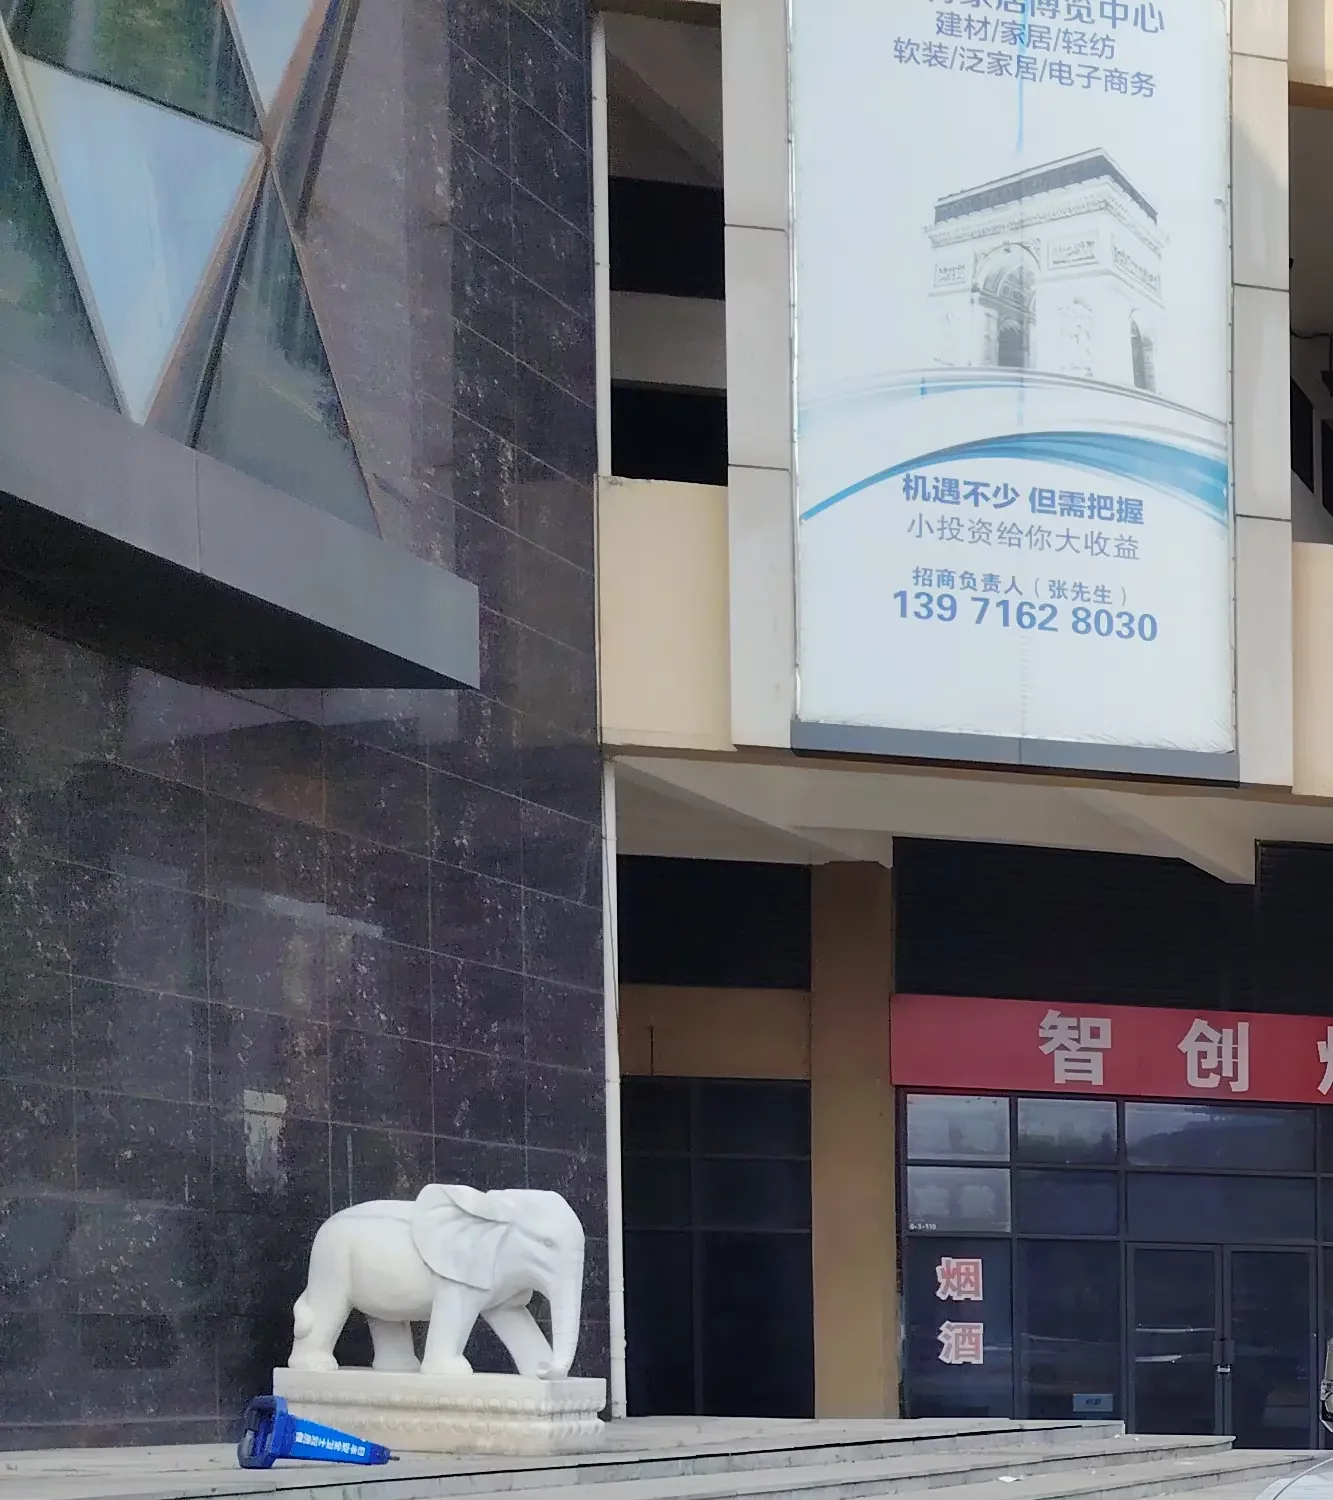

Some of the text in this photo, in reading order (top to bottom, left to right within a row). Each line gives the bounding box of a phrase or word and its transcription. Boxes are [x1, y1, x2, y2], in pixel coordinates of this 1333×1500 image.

[935, 10, 1117, 60] 建材/家居/轻纺
[893, 36, 1157, 98] 软装/泛家居/电子商务
[902, 472, 1145, 525] 机遇不少 但需把握
[906, 512, 1140, 561] 小投资给你大收益
[893, 590, 1158, 642] 139 7162 8030
